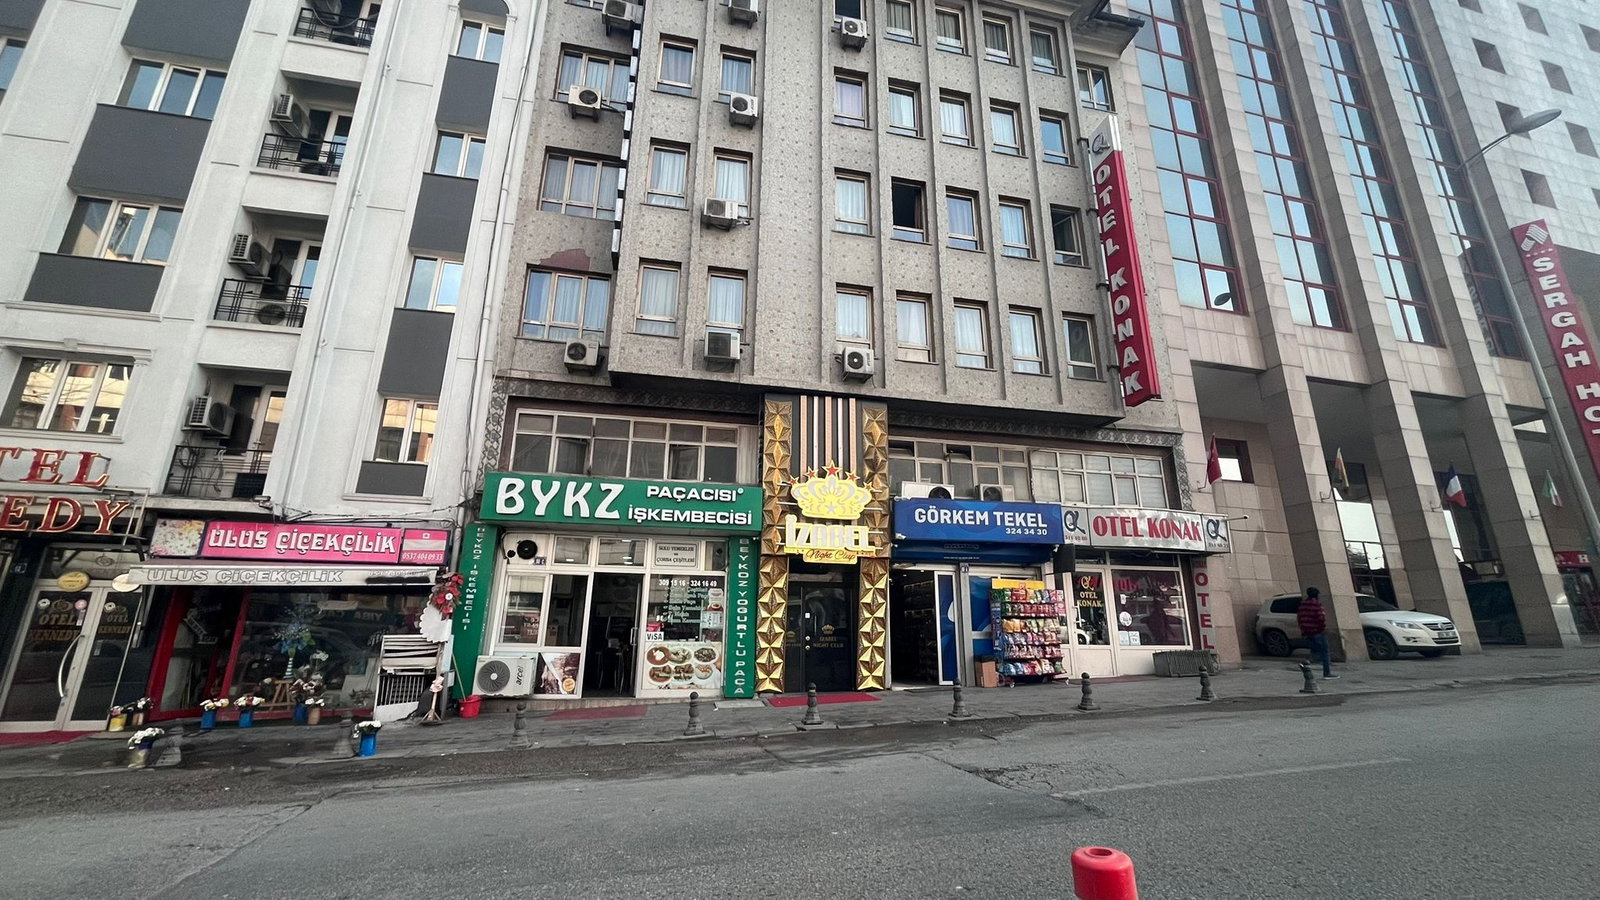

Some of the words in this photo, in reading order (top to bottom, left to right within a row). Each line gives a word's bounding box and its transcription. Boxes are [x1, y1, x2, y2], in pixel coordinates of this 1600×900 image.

[1096, 164, 1120, 257] OTEL
[1110, 267, 1144, 396] KONAK
[1532, 257, 1592, 369] SERGAH
[495, 477, 626, 519] BYKZ
[914, 505, 989, 526] GÖRKEM
[992, 510, 1049, 528] TEKEL
[1092, 515, 1145, 538] OTEL
[1147, 517, 1203, 542] KONAK
[208, 528, 269, 549] ULUS
[274, 529, 397, 556] ÇİÇEKÇİLİK
[1005, 527, 1022, 536] 324
[1023, 528, 1036, 536] 34
[1036, 528, 1049, 536] 30
[805, 549, 833, 562] Night
[148, 568, 210, 582] ULUS
[1080, 591, 1098, 599] OTEL
[1194, 572, 1215, 650] OTEL
